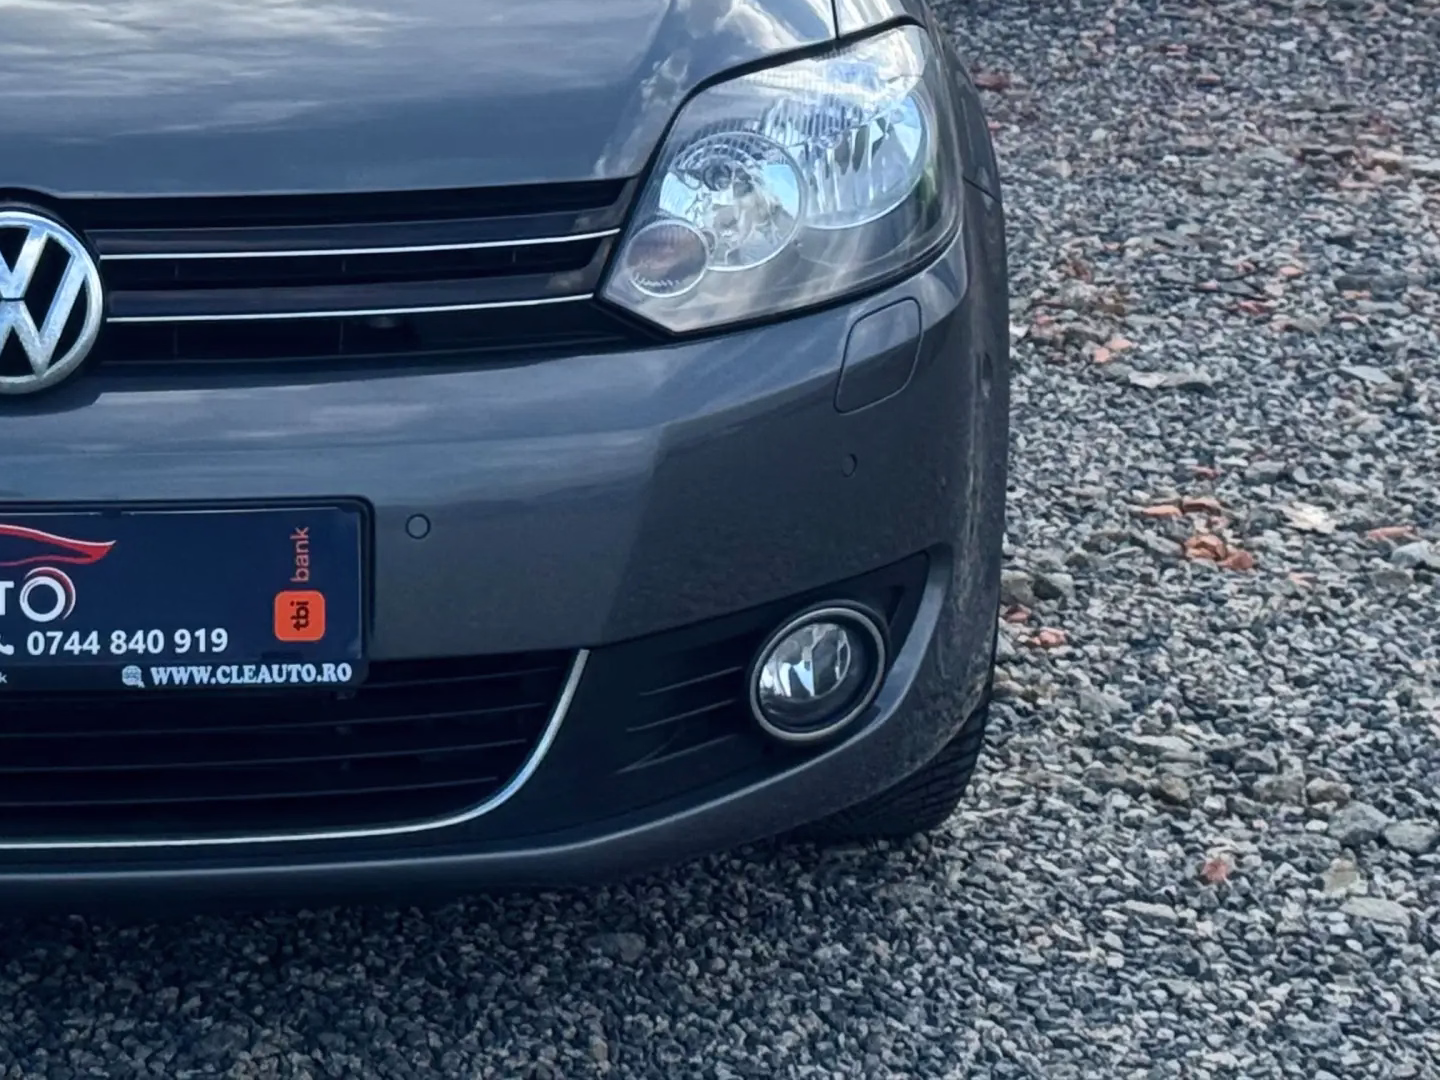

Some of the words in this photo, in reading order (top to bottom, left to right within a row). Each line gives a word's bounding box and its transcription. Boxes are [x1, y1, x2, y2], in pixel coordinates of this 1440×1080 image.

[289, 525, 310, 584] bank
[289, 599, 310, 633] tbi
[26, 630, 101, 656] 0744
[109, 628, 165, 655] 840
[173, 627, 229, 654] 919
[150, 662, 353, 686] WWW.CLEAUTO.RO
